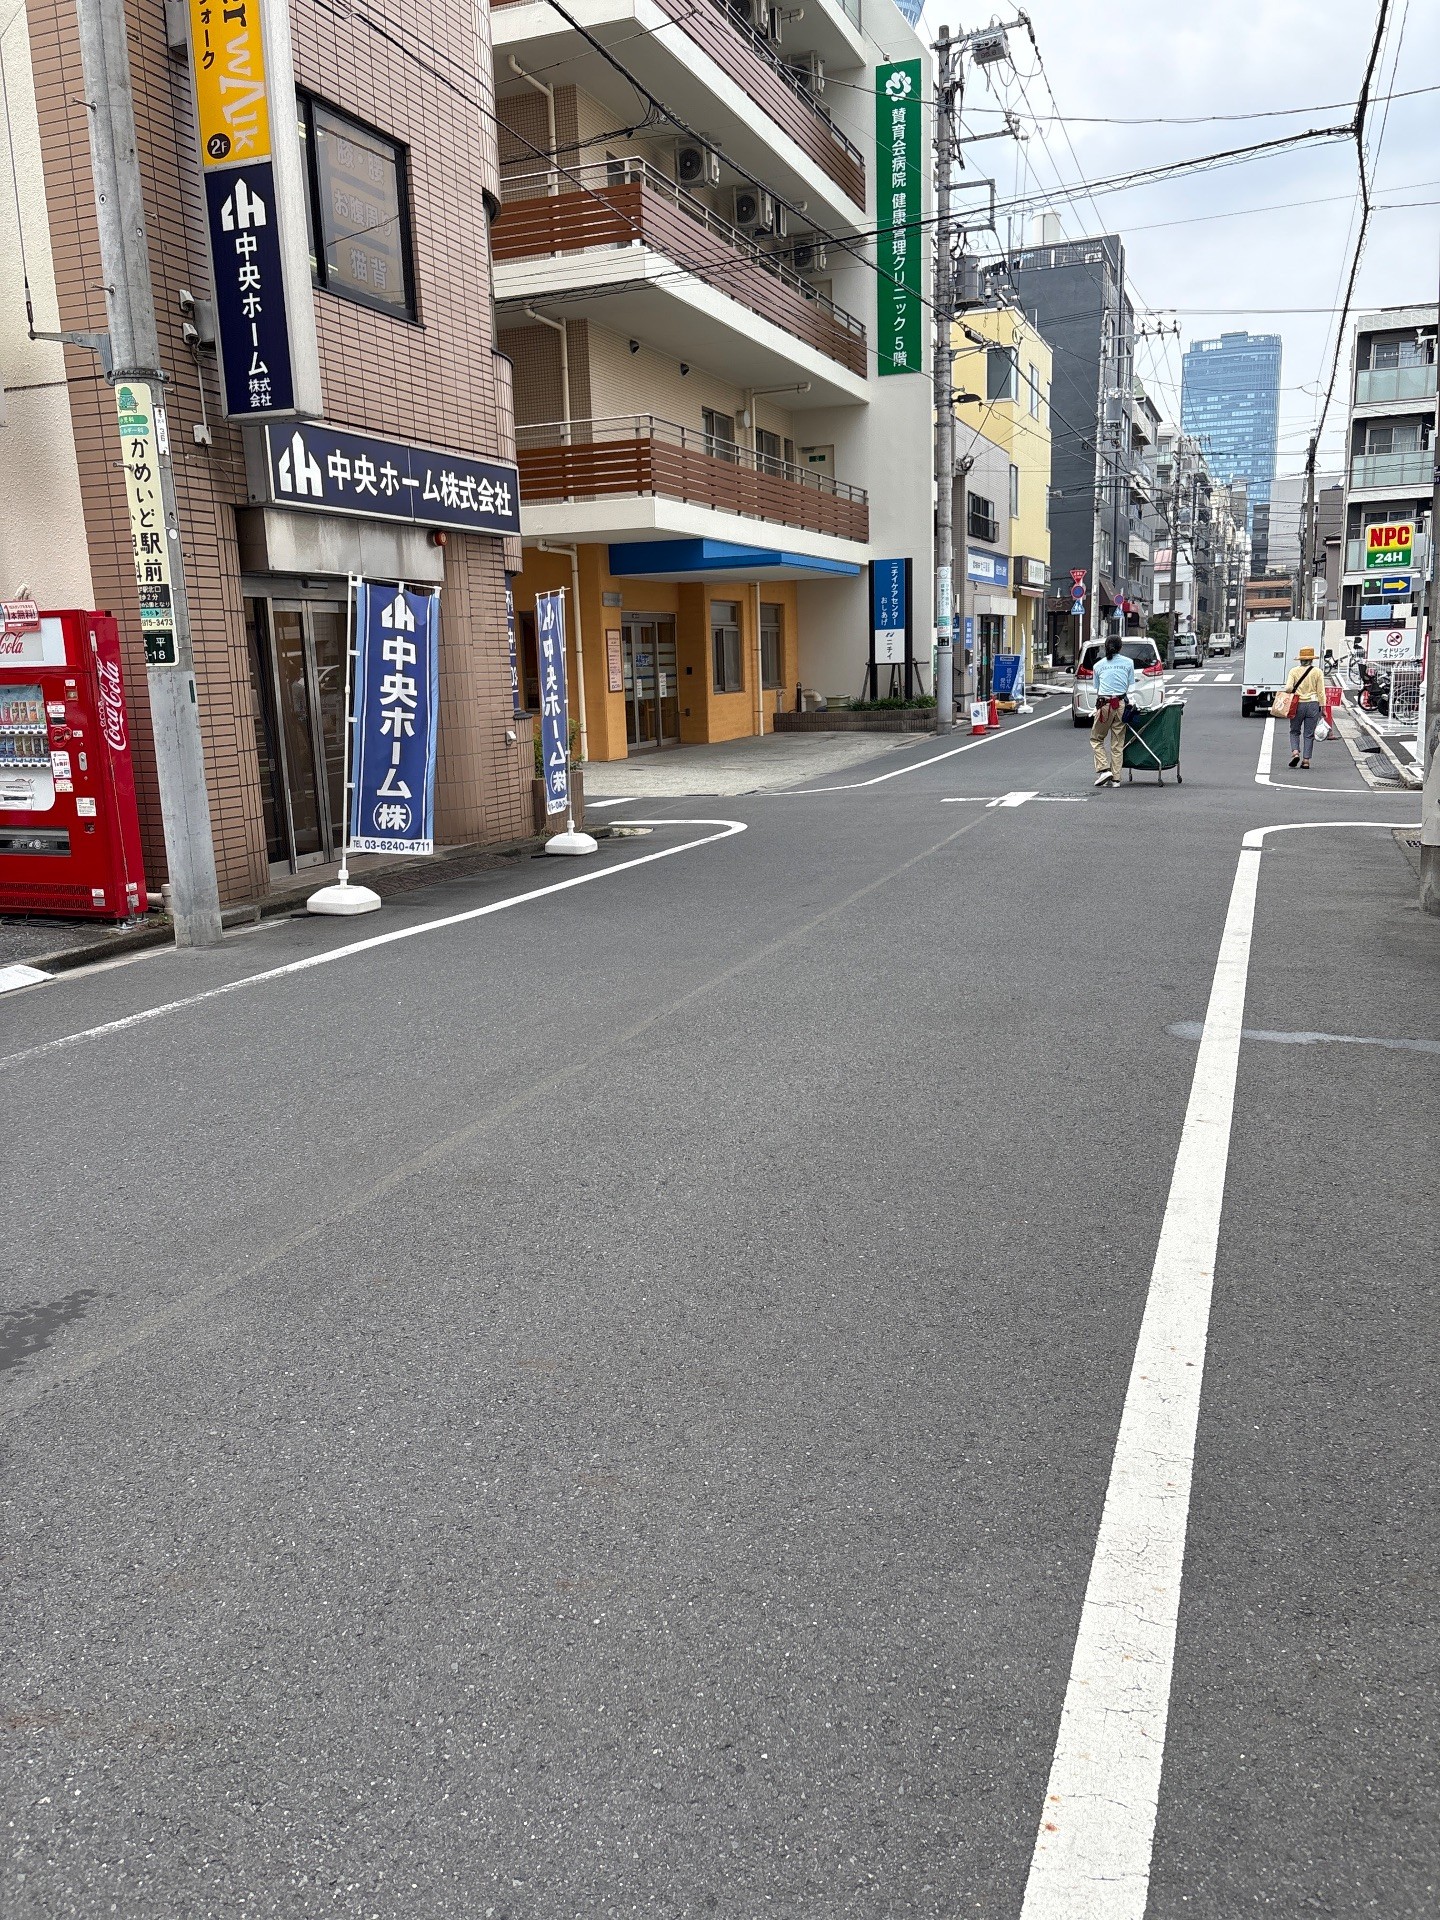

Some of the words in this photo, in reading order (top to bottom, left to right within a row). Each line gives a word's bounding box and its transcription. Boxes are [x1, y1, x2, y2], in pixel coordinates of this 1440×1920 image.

[210, 138, 227, 155] 2F
[892, 107, 907, 188] 賛育会病院
[333, 188, 392, 238] お腹周り
[350, 248, 388, 291] 猫背
[235, 232, 269, 375] 中央ホーム
[248, 377, 272, 393] 株式
[250, 392, 273, 408] 会社
[327, 449, 513, 517] 中央ホーム株式会社
[130, 438, 163, 582] かめいど駅前
[1370, 526, 1410, 548] NPC
[1374, 551, 1403, 563] 24H
[891, 562, 899, 626] ニチイケアセンター
[353, 840, 362, 849] TEL
[364, 840, 429, 851] 03-6240-4711
